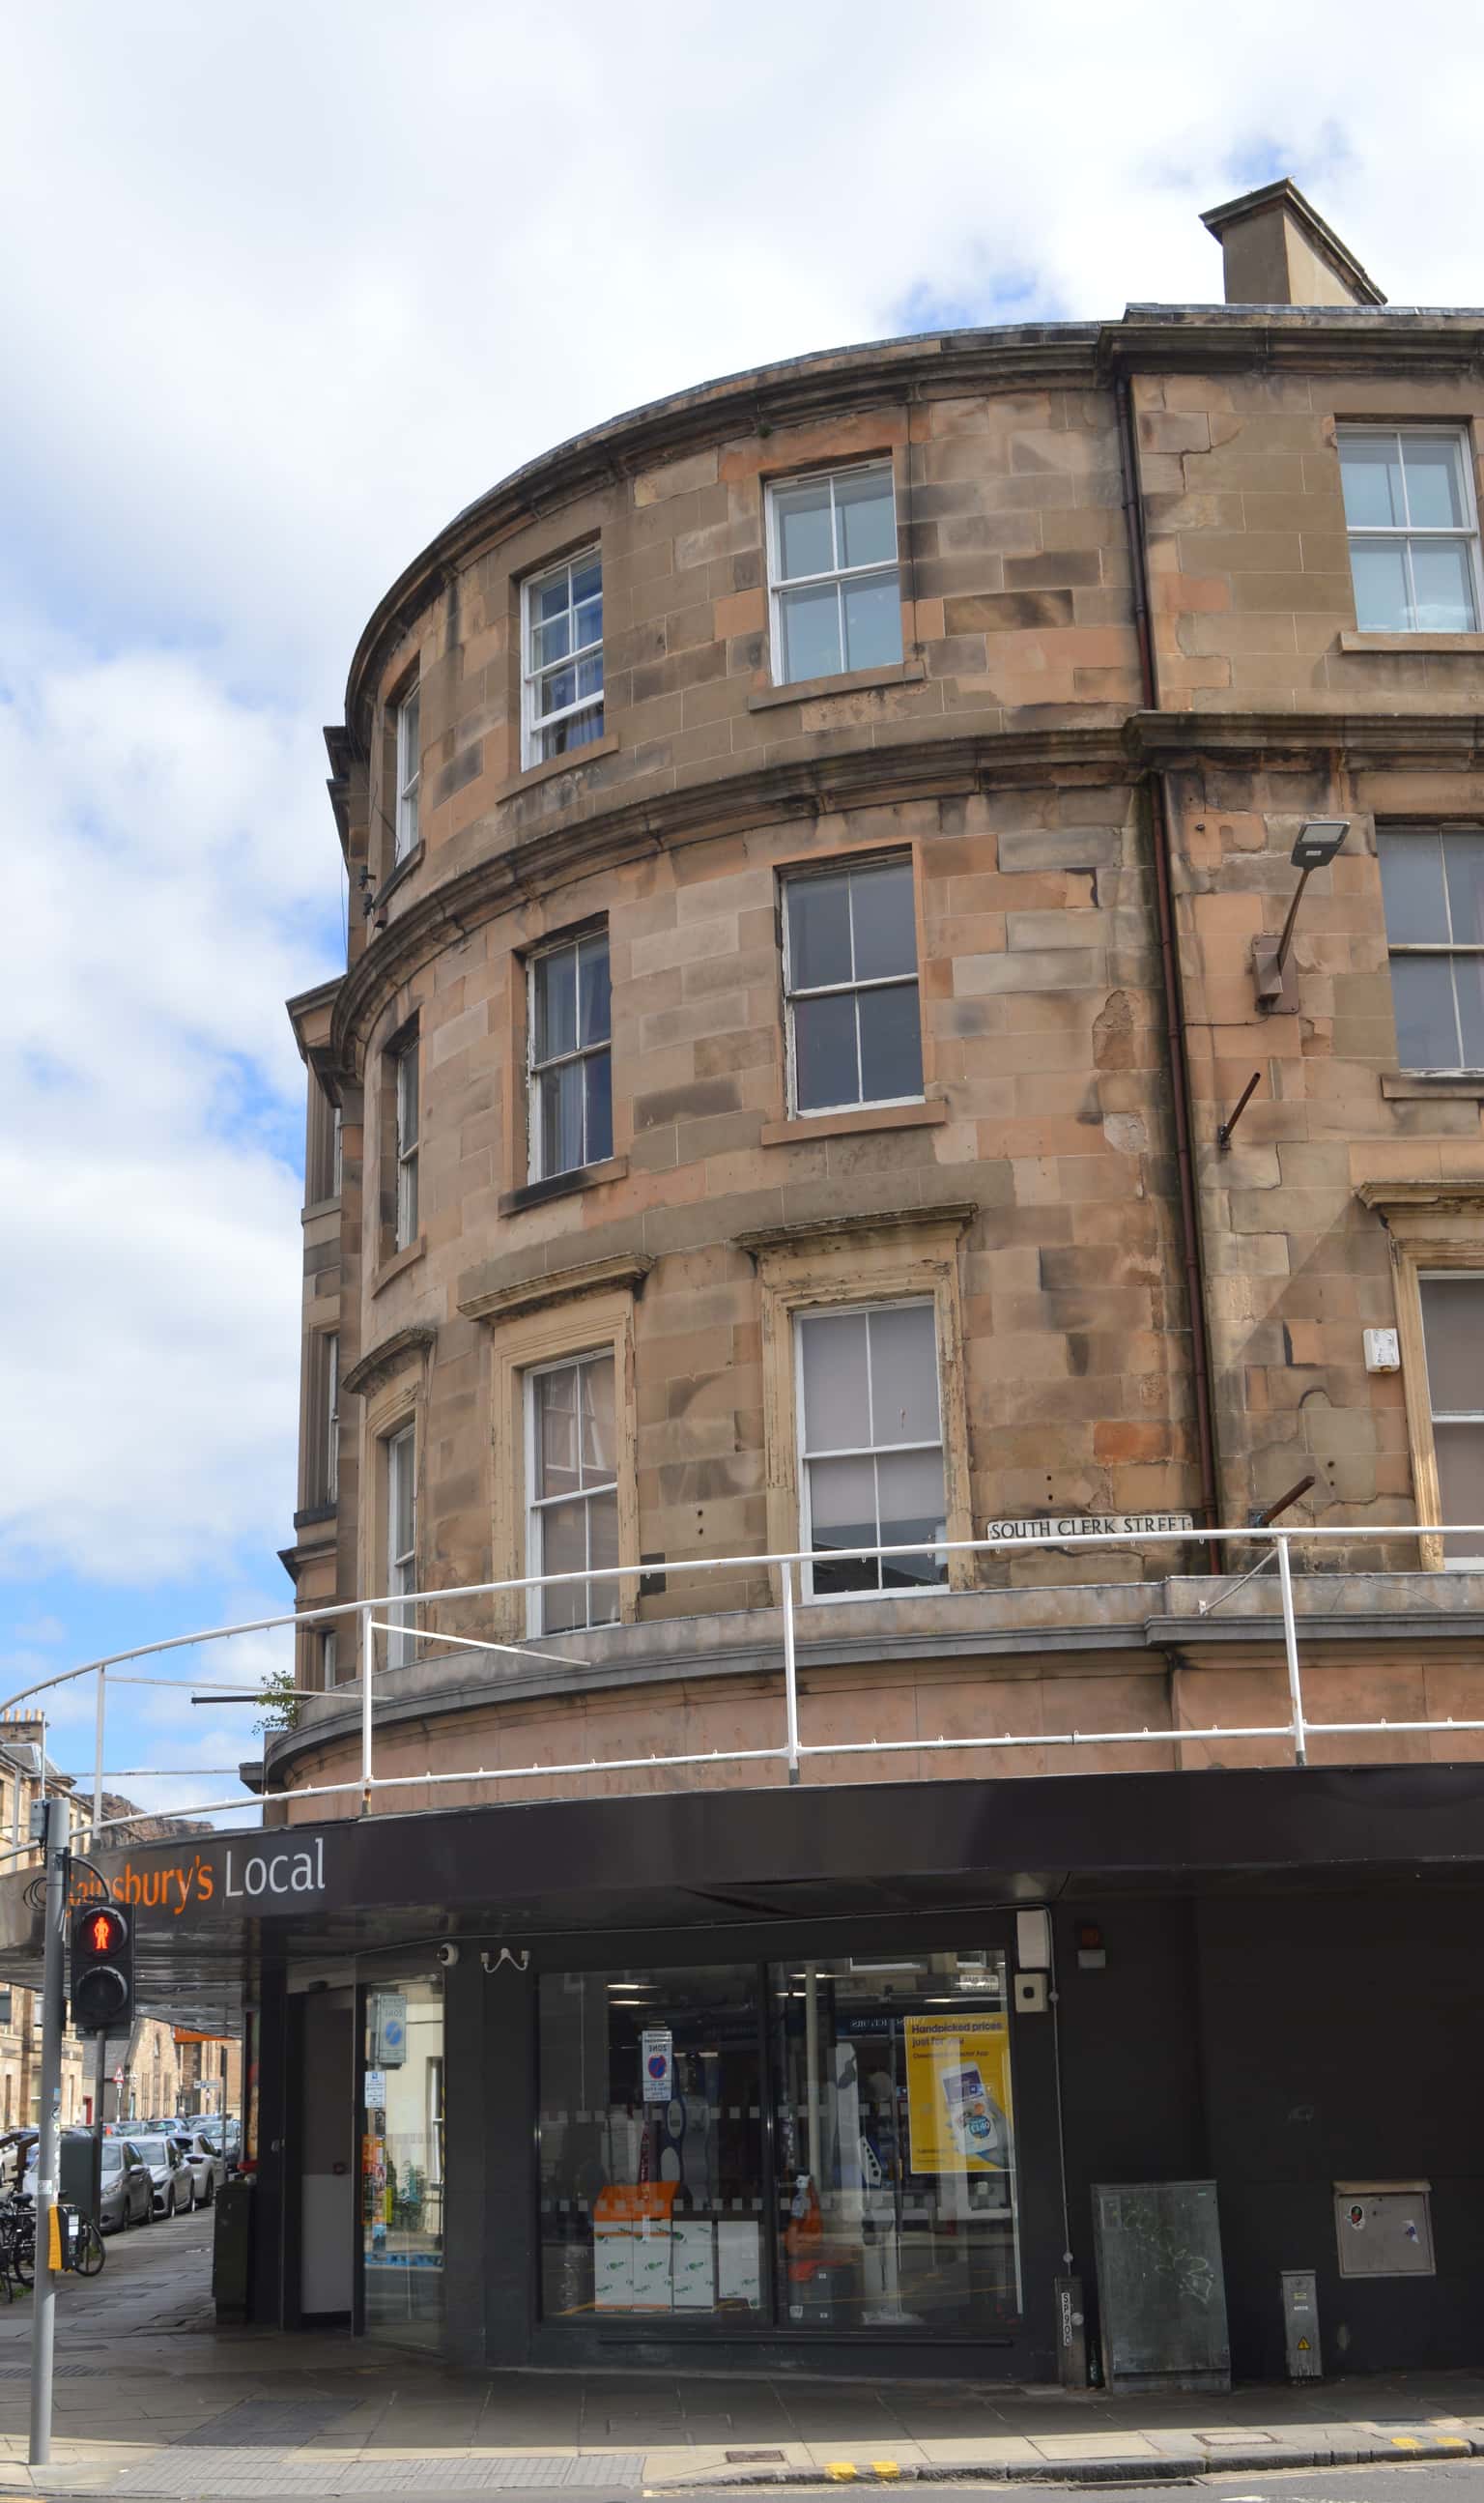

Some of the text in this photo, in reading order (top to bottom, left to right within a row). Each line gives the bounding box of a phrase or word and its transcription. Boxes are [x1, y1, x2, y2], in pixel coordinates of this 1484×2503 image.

[991, 1516, 1185, 1539] SOUTH CLERK STREET
[225, 1837, 325, 1897] Local
